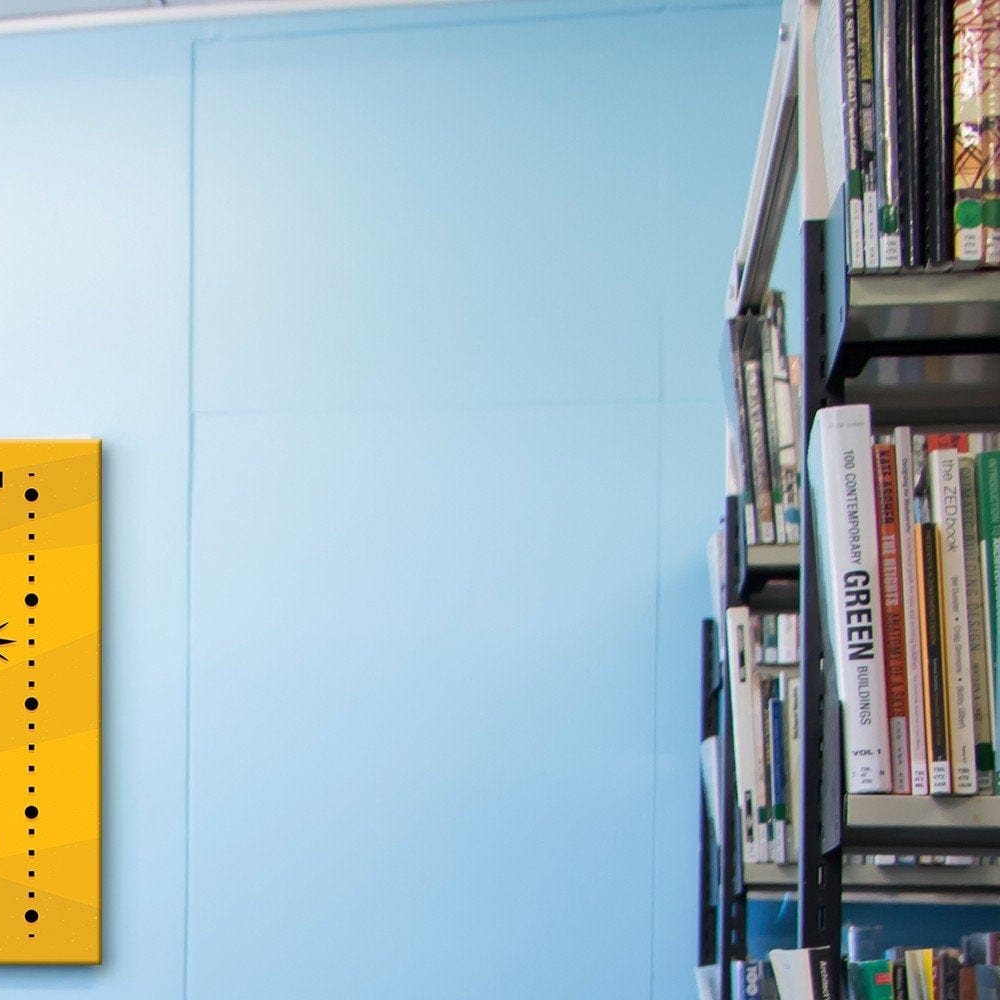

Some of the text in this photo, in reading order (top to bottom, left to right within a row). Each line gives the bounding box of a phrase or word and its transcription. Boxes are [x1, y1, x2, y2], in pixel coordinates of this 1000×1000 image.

[843, 449, 855, 470] 100
[942, 460, 956, 481] the
[845, 473, 862, 565] CONTEMPORARY
[942, 486, 959, 553] ZEDbook
[881, 535, 896, 555] THE
[844, 569, 875, 661] GREEN
[887, 613, 903, 661] ANATOMY
[889, 666, 903, 677] OF
[857, 665, 872, 726] BUILDINGS
[852, 749, 874, 757] VOL
[746, 965, 759, 996] 100
